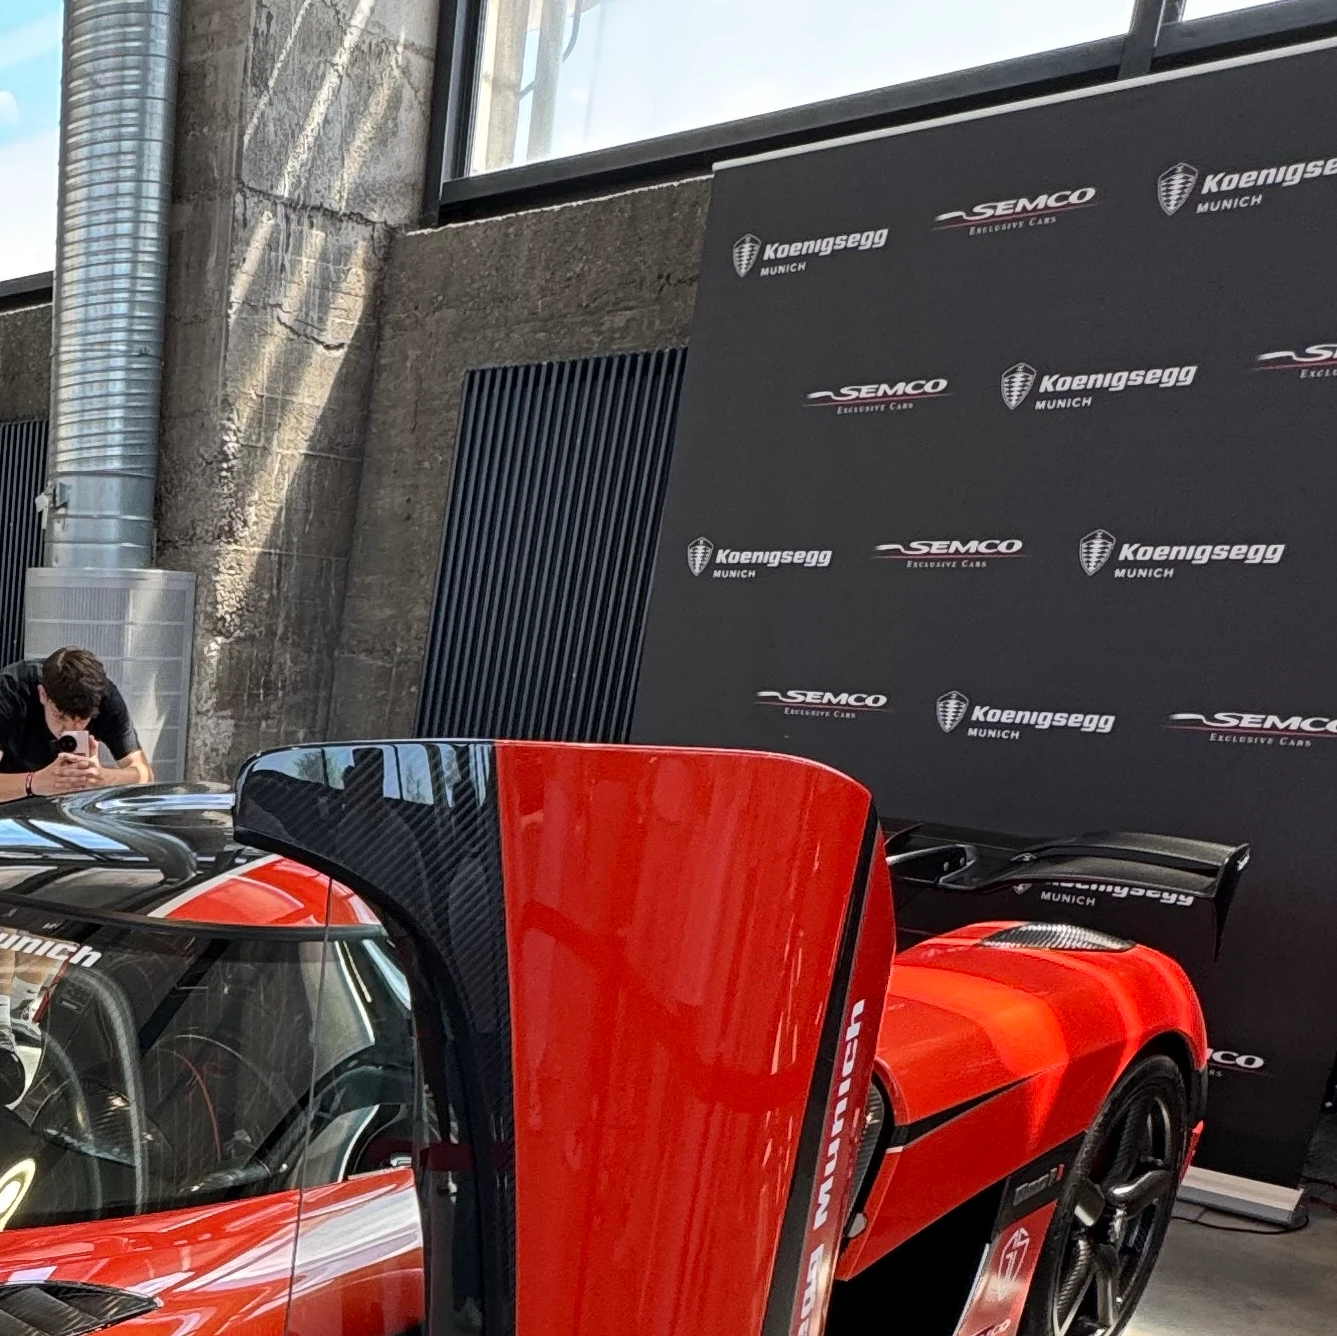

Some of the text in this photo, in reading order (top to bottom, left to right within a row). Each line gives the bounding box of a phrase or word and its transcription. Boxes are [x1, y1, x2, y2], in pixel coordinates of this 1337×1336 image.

[935, 187, 1096, 222] SEMCO
[1196, 194, 1263, 214] MUNICH
[763, 228, 889, 261] Koenigsegg
[760, 261, 807, 277] MUNICH
[1039, 365, 1198, 393] Koenigsegg
[807, 378, 948, 401] SEMCO
[1034, 396, 1093, 411] MUNICH
[875, 539, 1023, 555] SEMCO
[1118, 543, 1286, 565] Koenigsegg
[715, 549, 833, 567] Koenigsegg
[713, 569, 756, 579] MUNICH
[1114, 567, 1175, 578] MUNICH
[757, 690, 887, 707] SEMCO
[971, 705, 1116, 733] Koenigsegg
[967, 727, 1020, 740] MUNICH
[1040, 890, 1096, 907] MUNICH
[814, 999, 865, 1230] Munich
